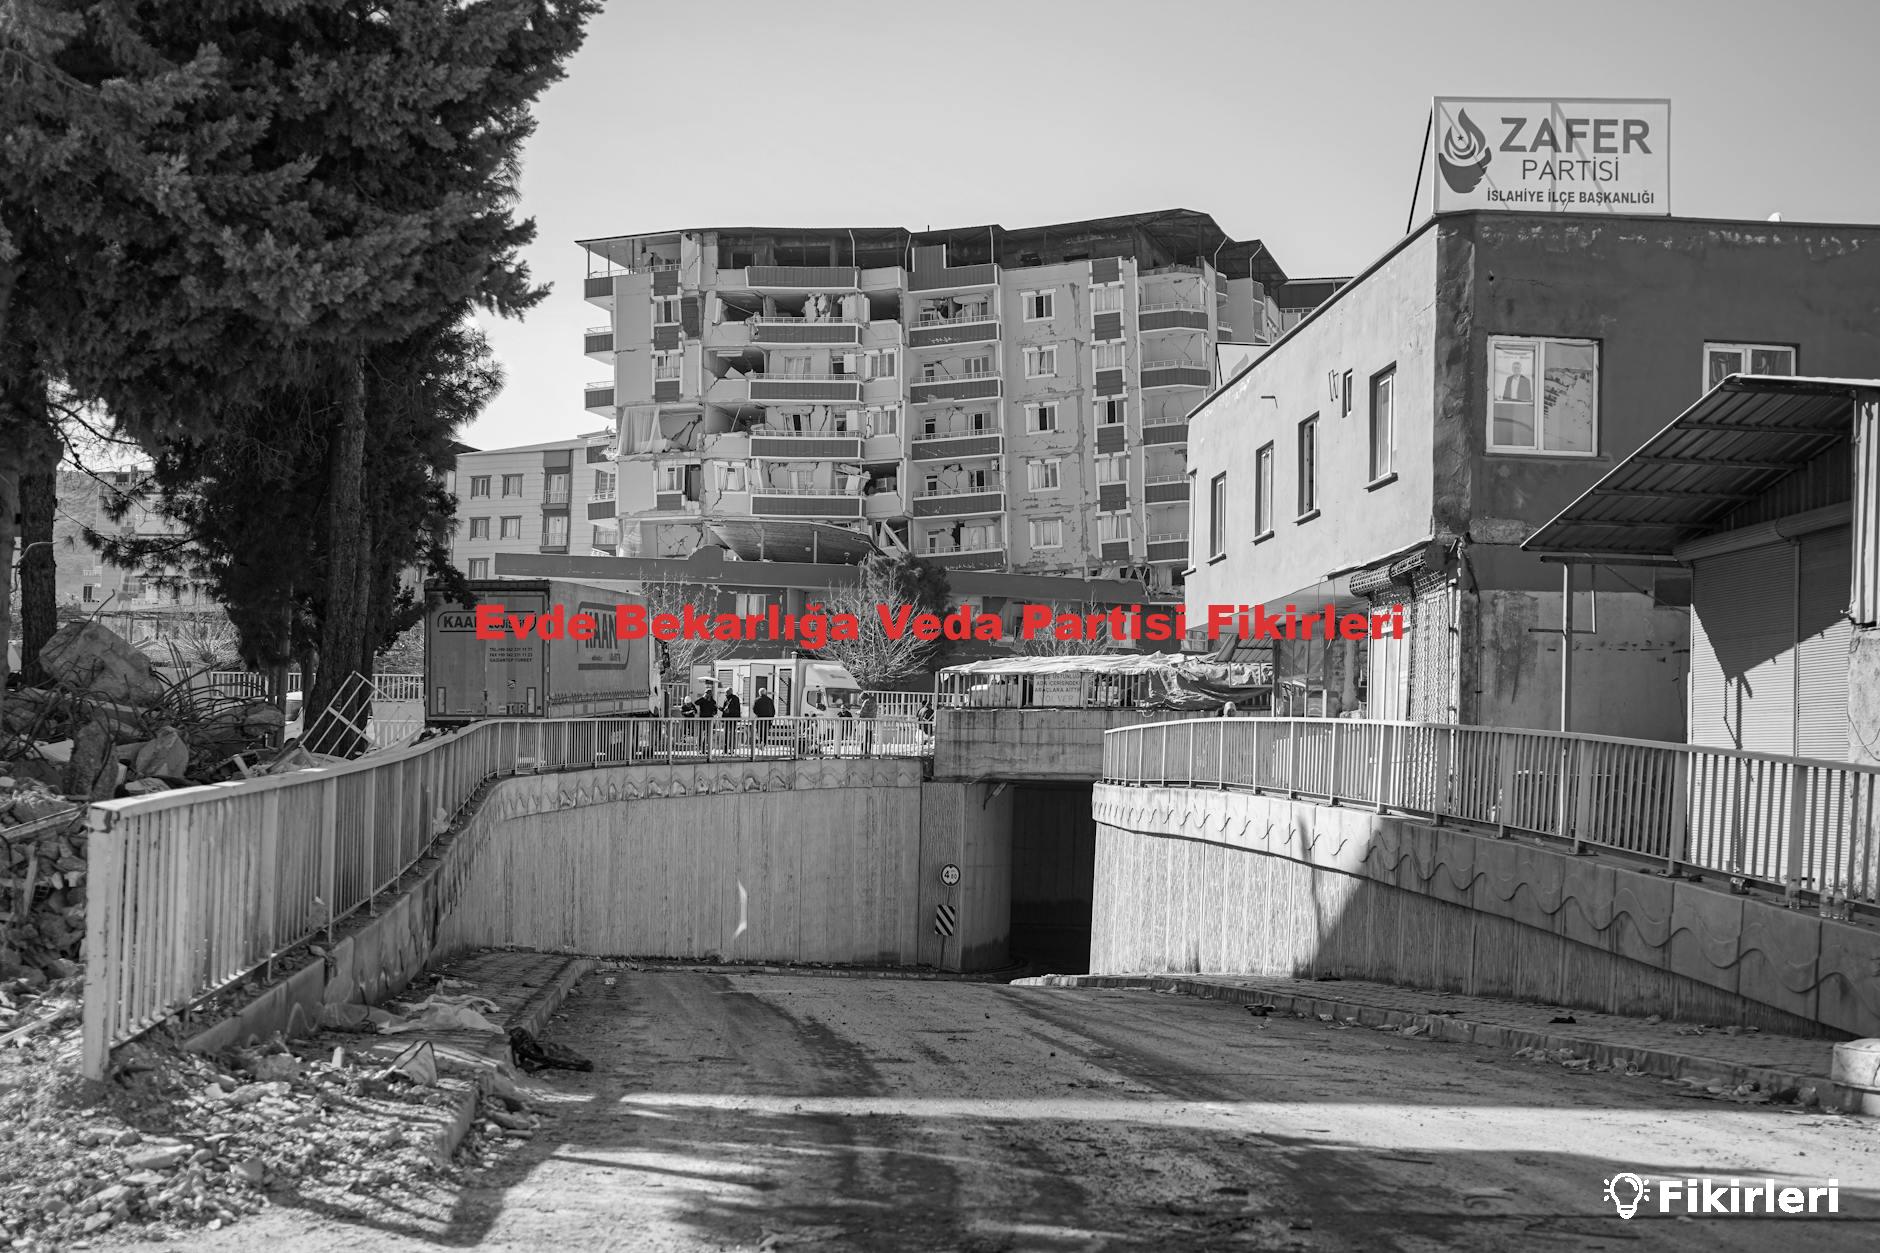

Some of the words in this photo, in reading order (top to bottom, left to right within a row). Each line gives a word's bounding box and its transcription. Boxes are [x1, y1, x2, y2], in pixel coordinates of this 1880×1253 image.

[1499, 116, 1653, 155] ZAFER
[1522, 156, 1619, 182] PARTİSİ
[1487, 187, 1544, 203] İSLAHİYE
[1548, 188, 1575, 206] İLÇE
[1579, 189, 1655, 206] BAŞKANLIĞI
[443, 615, 477, 629] KAA
